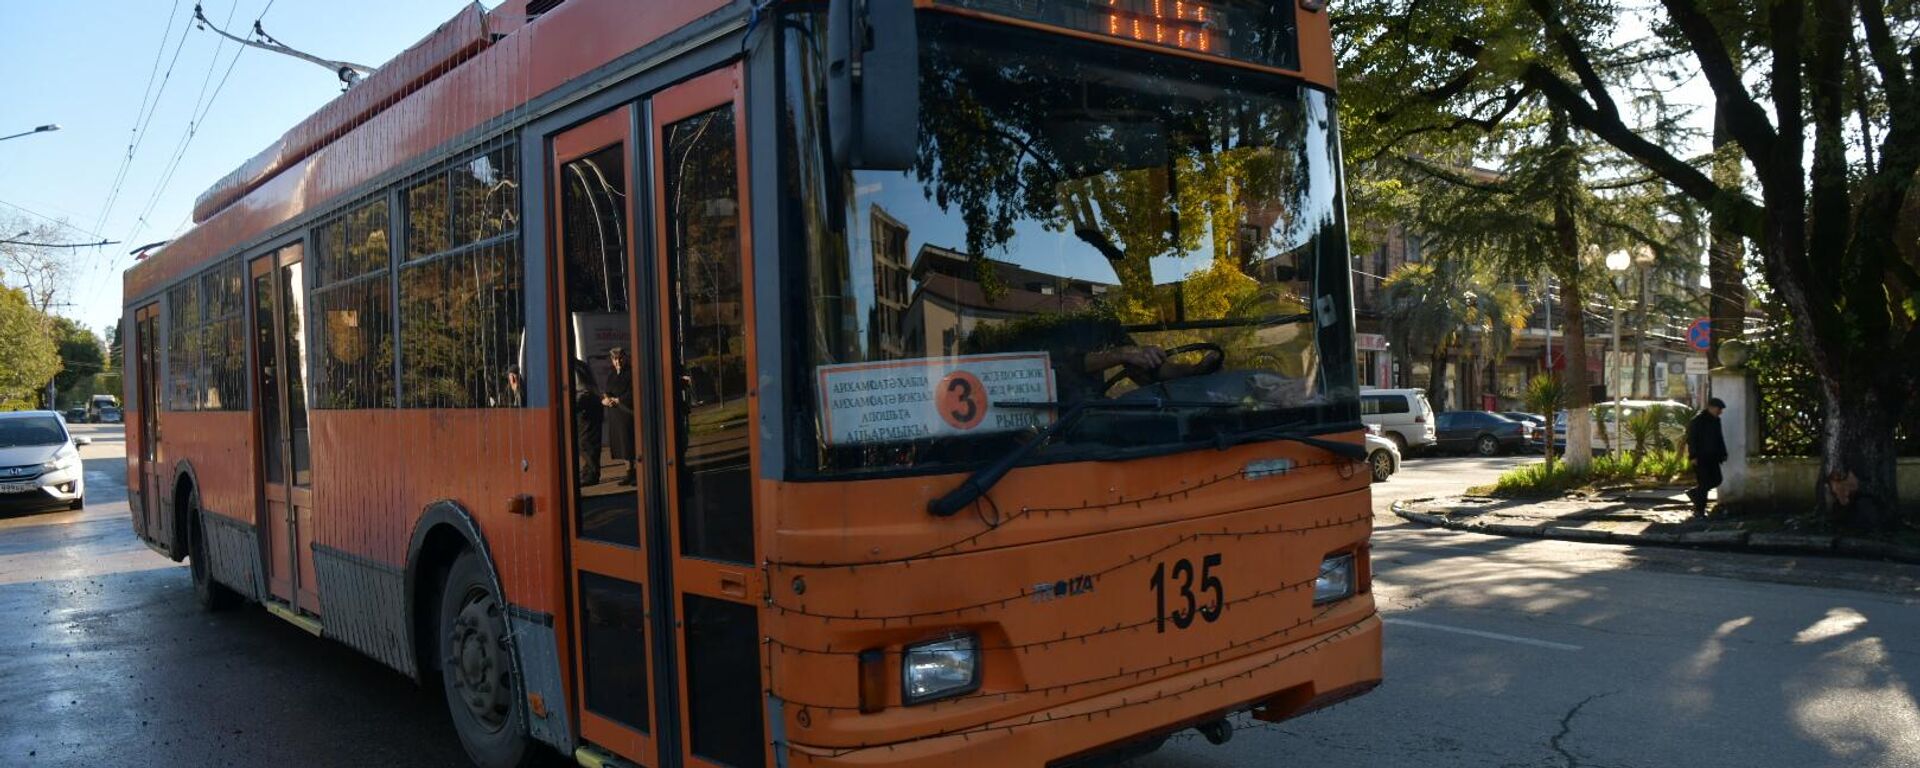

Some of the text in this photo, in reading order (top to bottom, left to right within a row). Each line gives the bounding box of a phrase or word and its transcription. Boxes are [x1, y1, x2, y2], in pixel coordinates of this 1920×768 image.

[947, 377, 977, 424] 3
[996, 412, 1041, 428] РЫНОК
[1150, 552, 1224, 633] 135
